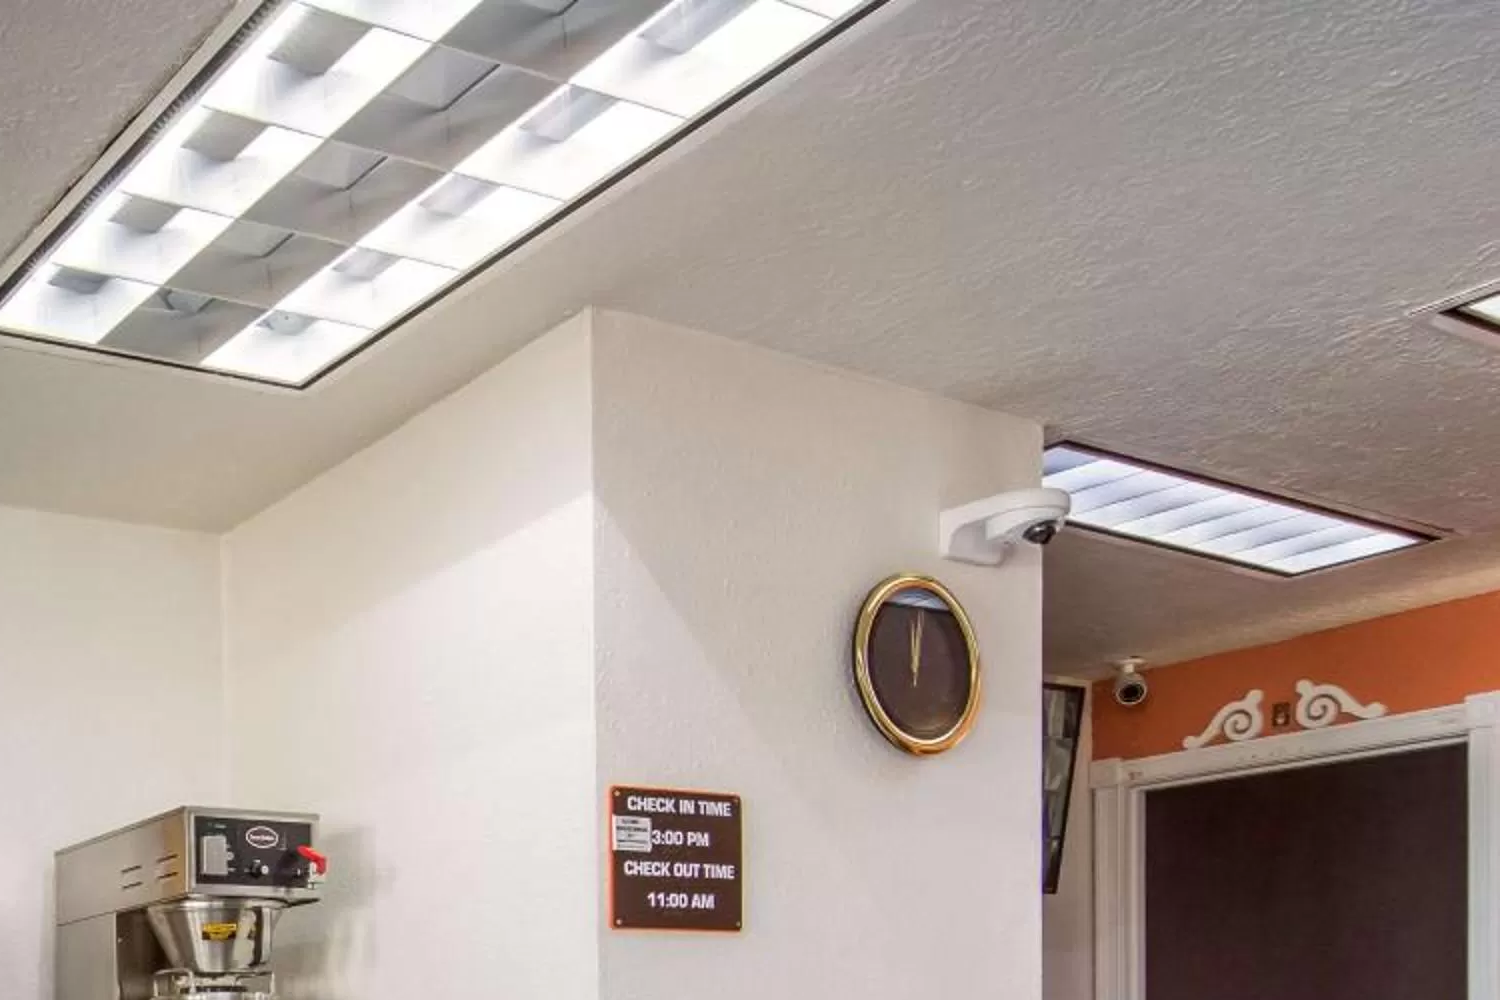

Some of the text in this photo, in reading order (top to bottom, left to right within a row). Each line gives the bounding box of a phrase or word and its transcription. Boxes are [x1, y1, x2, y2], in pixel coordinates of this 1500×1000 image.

[627, 795, 732, 817] CHECK IN TIME
[652, 829, 684, 846] 3:00
[687, 832, 709, 847] PM
[623, 860, 735, 880] CHECK OUT TIME
[647, 891, 715, 909] 11:00 AM
